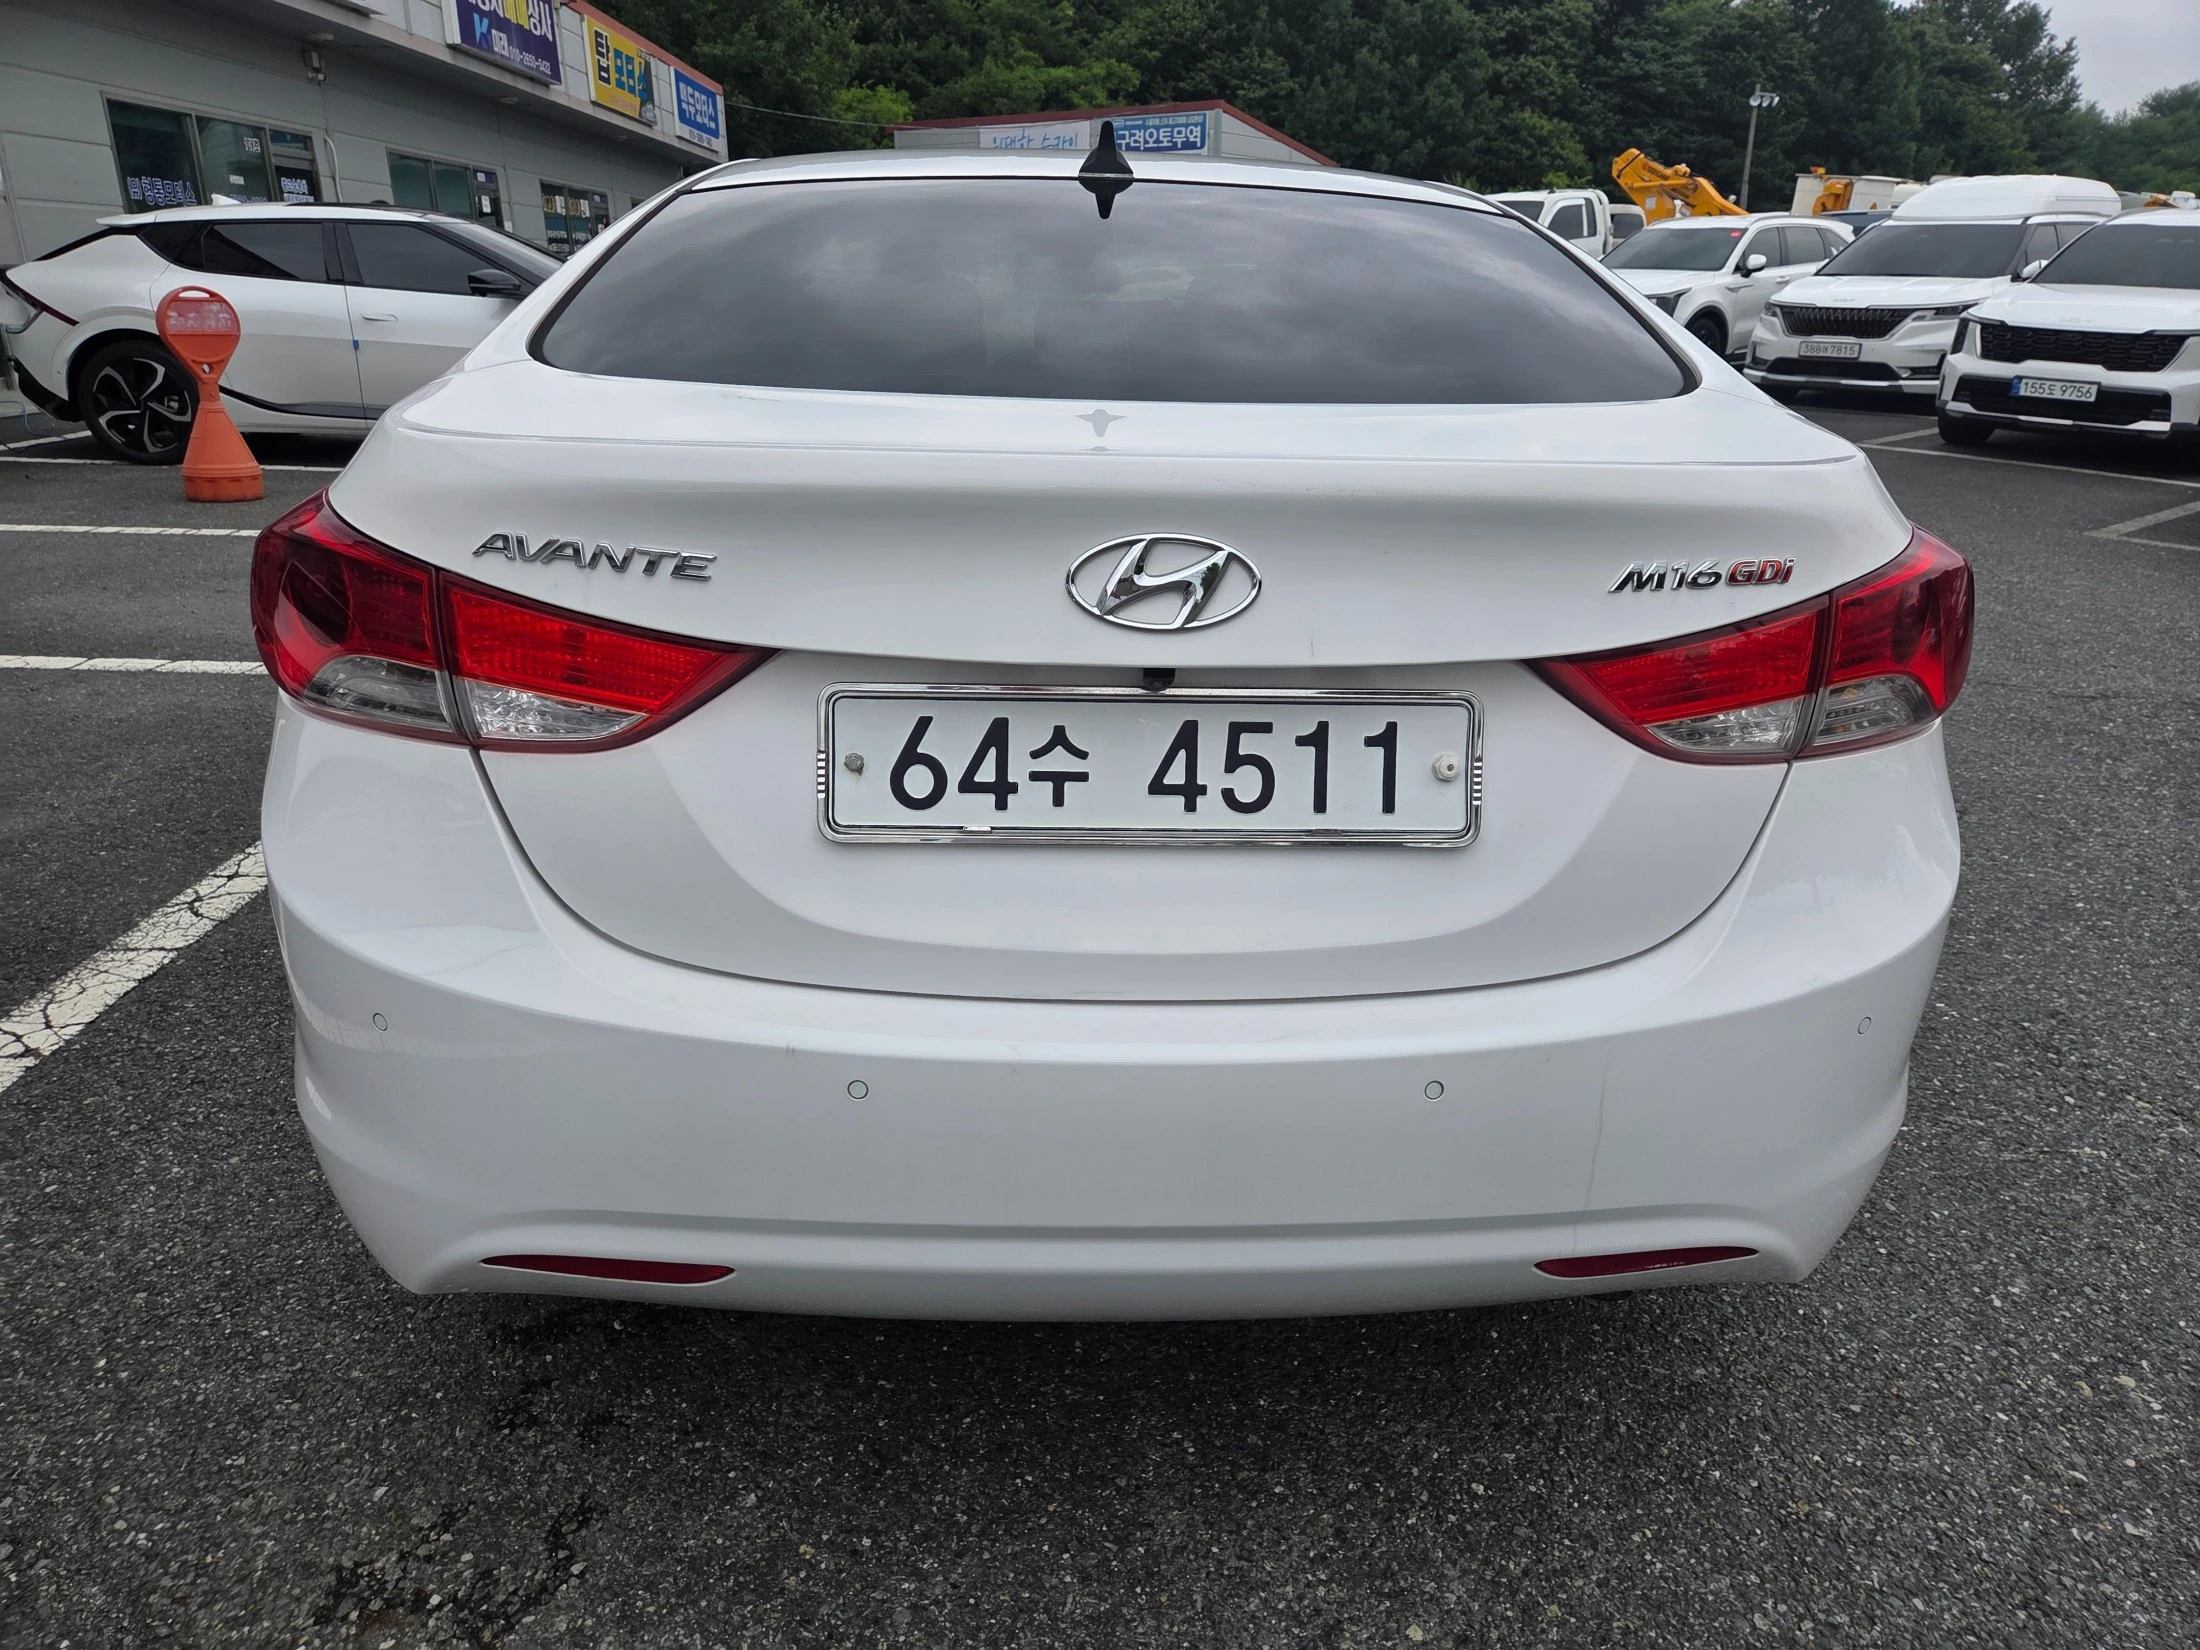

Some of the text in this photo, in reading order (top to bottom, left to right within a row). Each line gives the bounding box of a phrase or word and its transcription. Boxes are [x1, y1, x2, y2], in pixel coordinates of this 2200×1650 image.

[594, 28, 648, 101] 탑 모터스
[679, 81, 716, 129] 백두모터스
[2023, 381, 2093, 399] 155도 9756
[471, 532, 718, 581] AVANTE
[1608, 557, 1796, 593] M16 GDi
[889, 716, 1398, 814] 64수 4511
